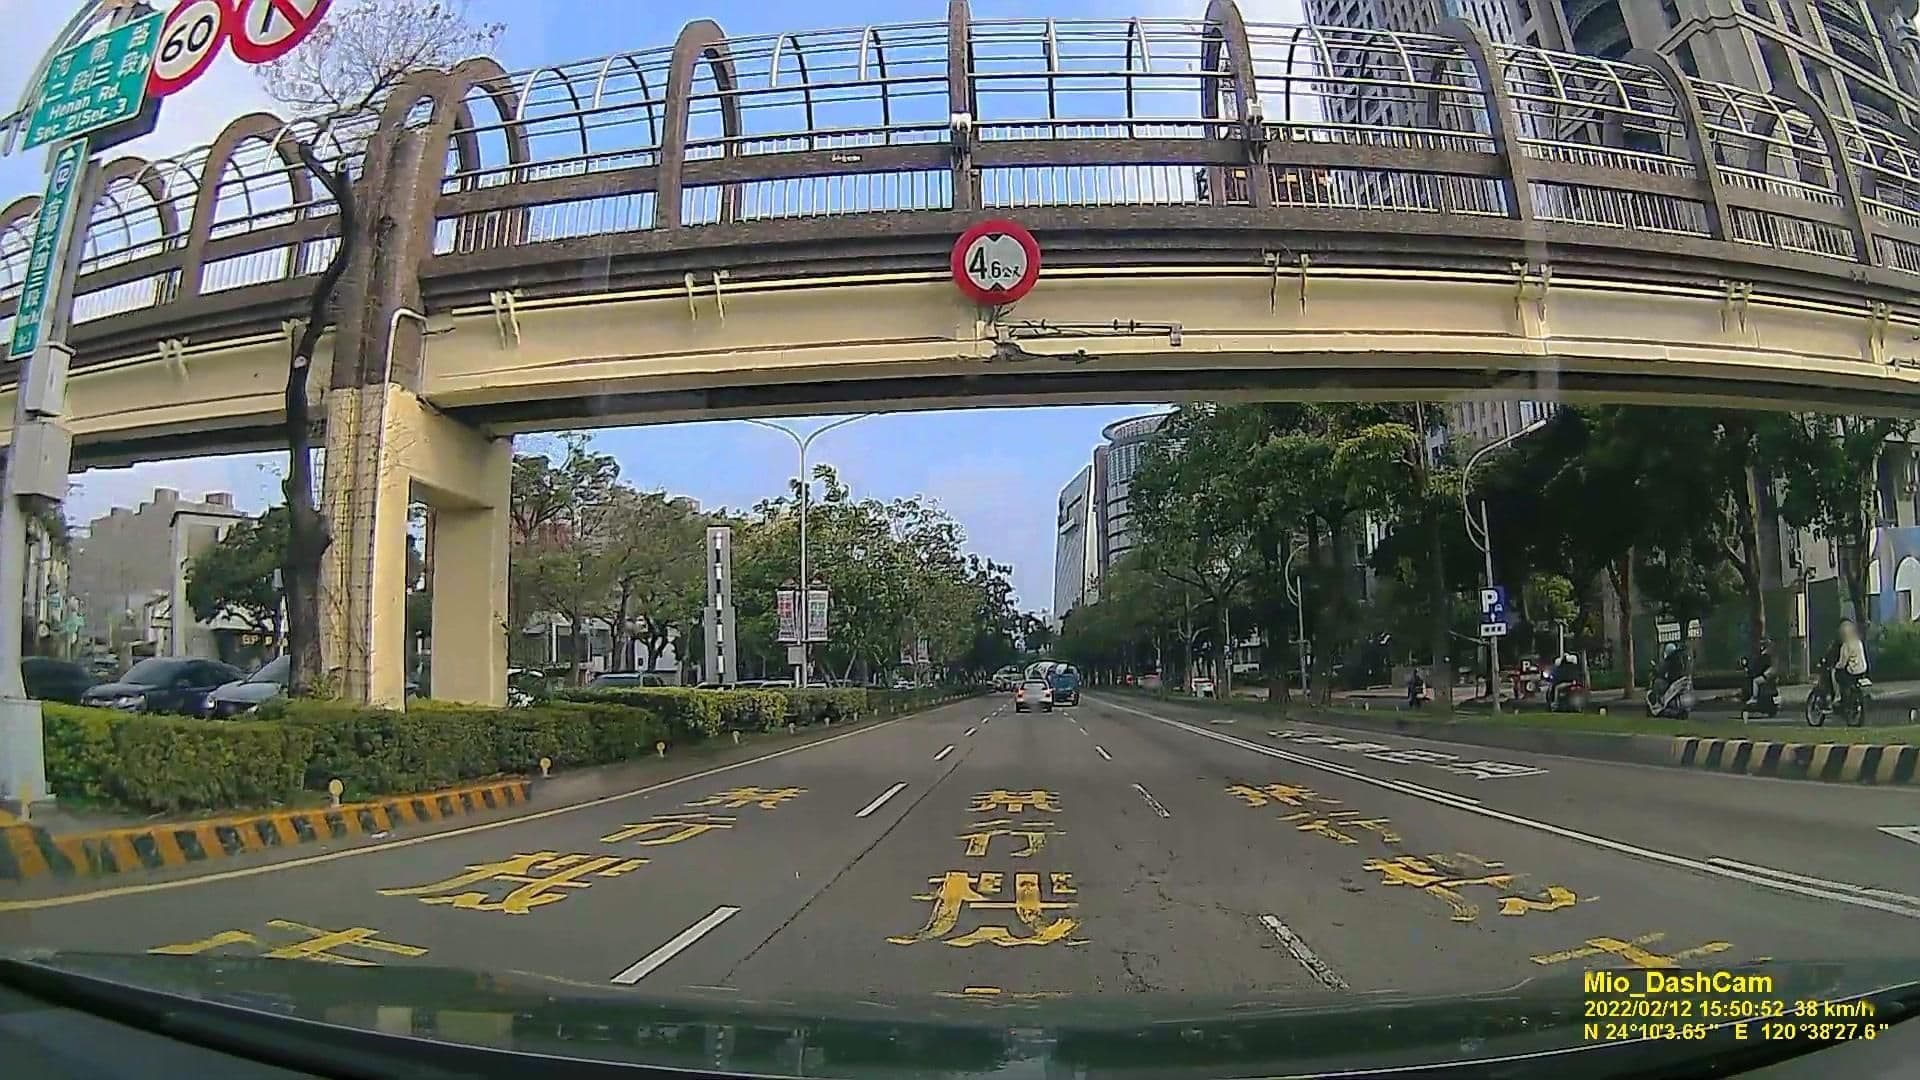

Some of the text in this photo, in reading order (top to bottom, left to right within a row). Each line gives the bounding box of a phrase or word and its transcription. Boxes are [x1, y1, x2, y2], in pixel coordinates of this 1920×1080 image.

[161, 15, 214, 62] 60
[49, 96, 91, 121] Henan
[1481, 590, 1498, 613] P
